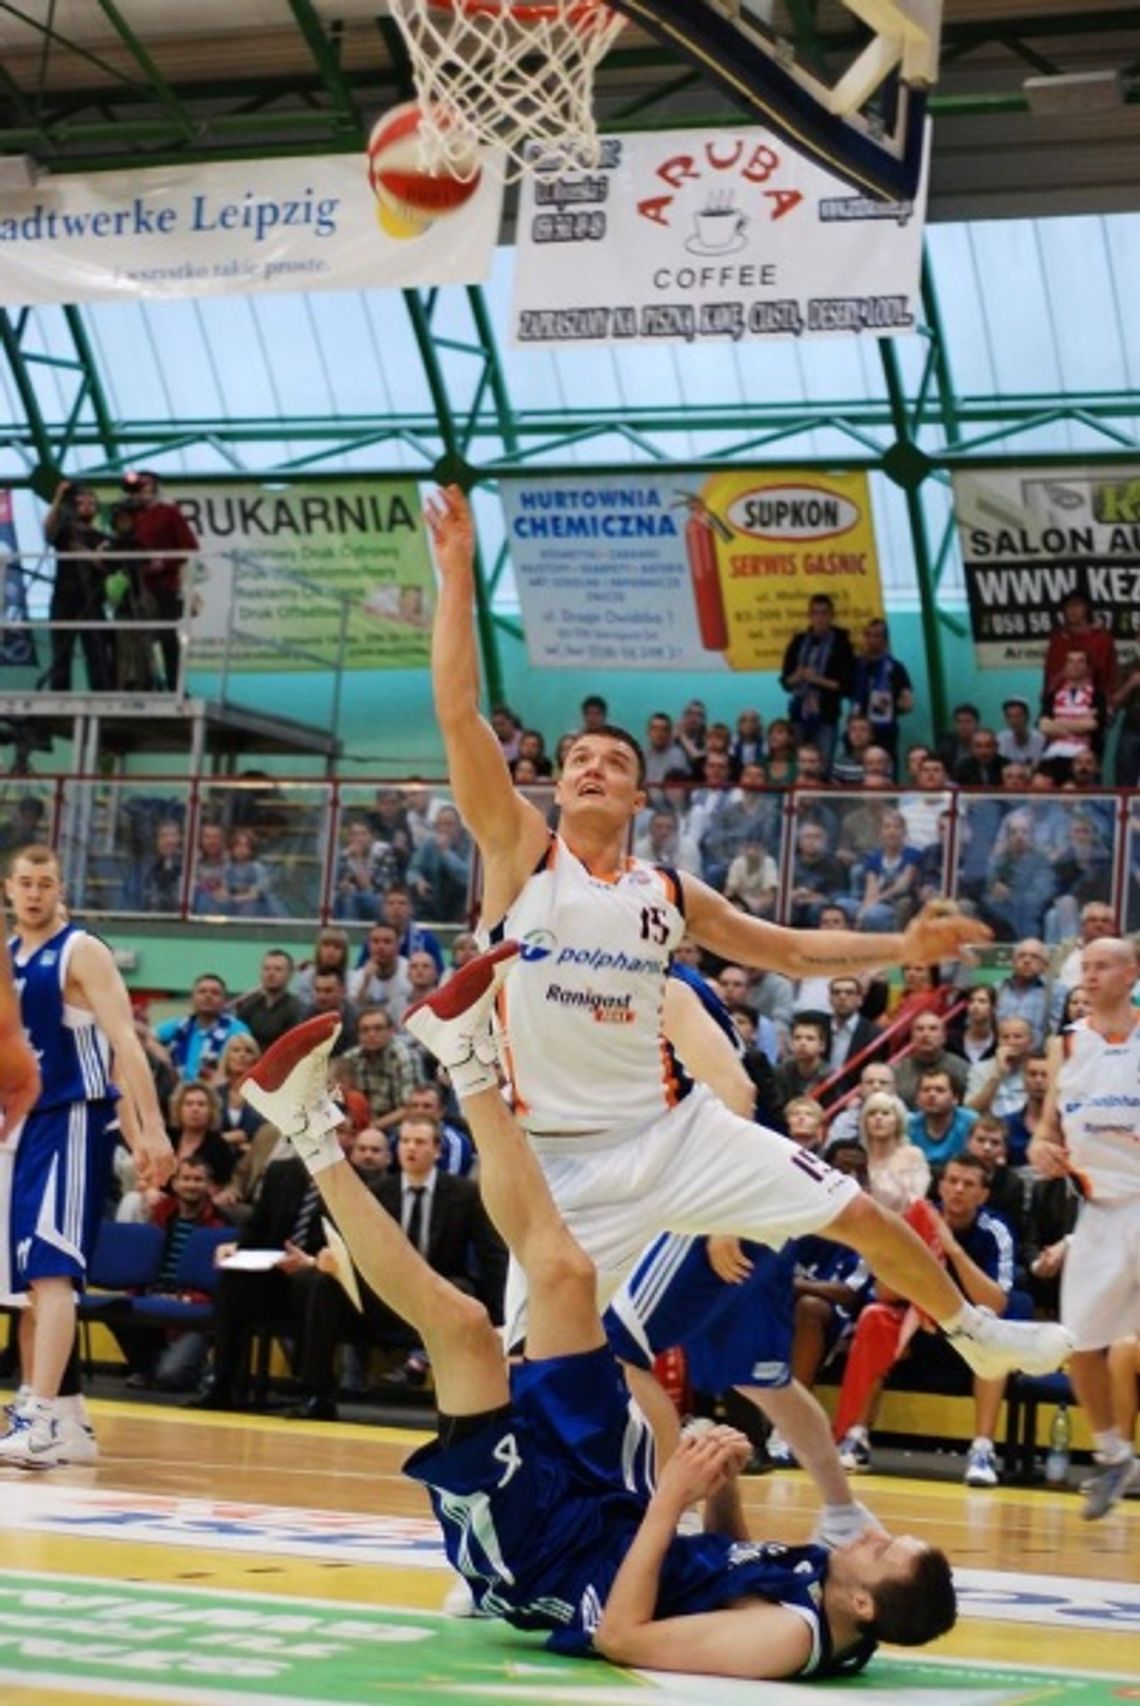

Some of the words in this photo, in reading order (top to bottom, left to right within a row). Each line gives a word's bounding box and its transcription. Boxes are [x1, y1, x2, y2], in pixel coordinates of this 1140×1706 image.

[637, 139, 804, 227] ARUBA
[191, 188, 340, 241] Leipzig
[653, 264, 777, 289] COFFEE
[520, 488, 661, 510] HURTOWNIA
[177, 496, 416, 536] RUKARNIA
[514, 514, 678, 539] CHEMICZNA
[744, 501, 839, 528] SUPKON
[971, 526, 1094, 556] SALON
[730, 553, 796, 578] SERWIS
[803, 551, 867, 576] GAŚNIC
[639, 905, 670, 946] 15
